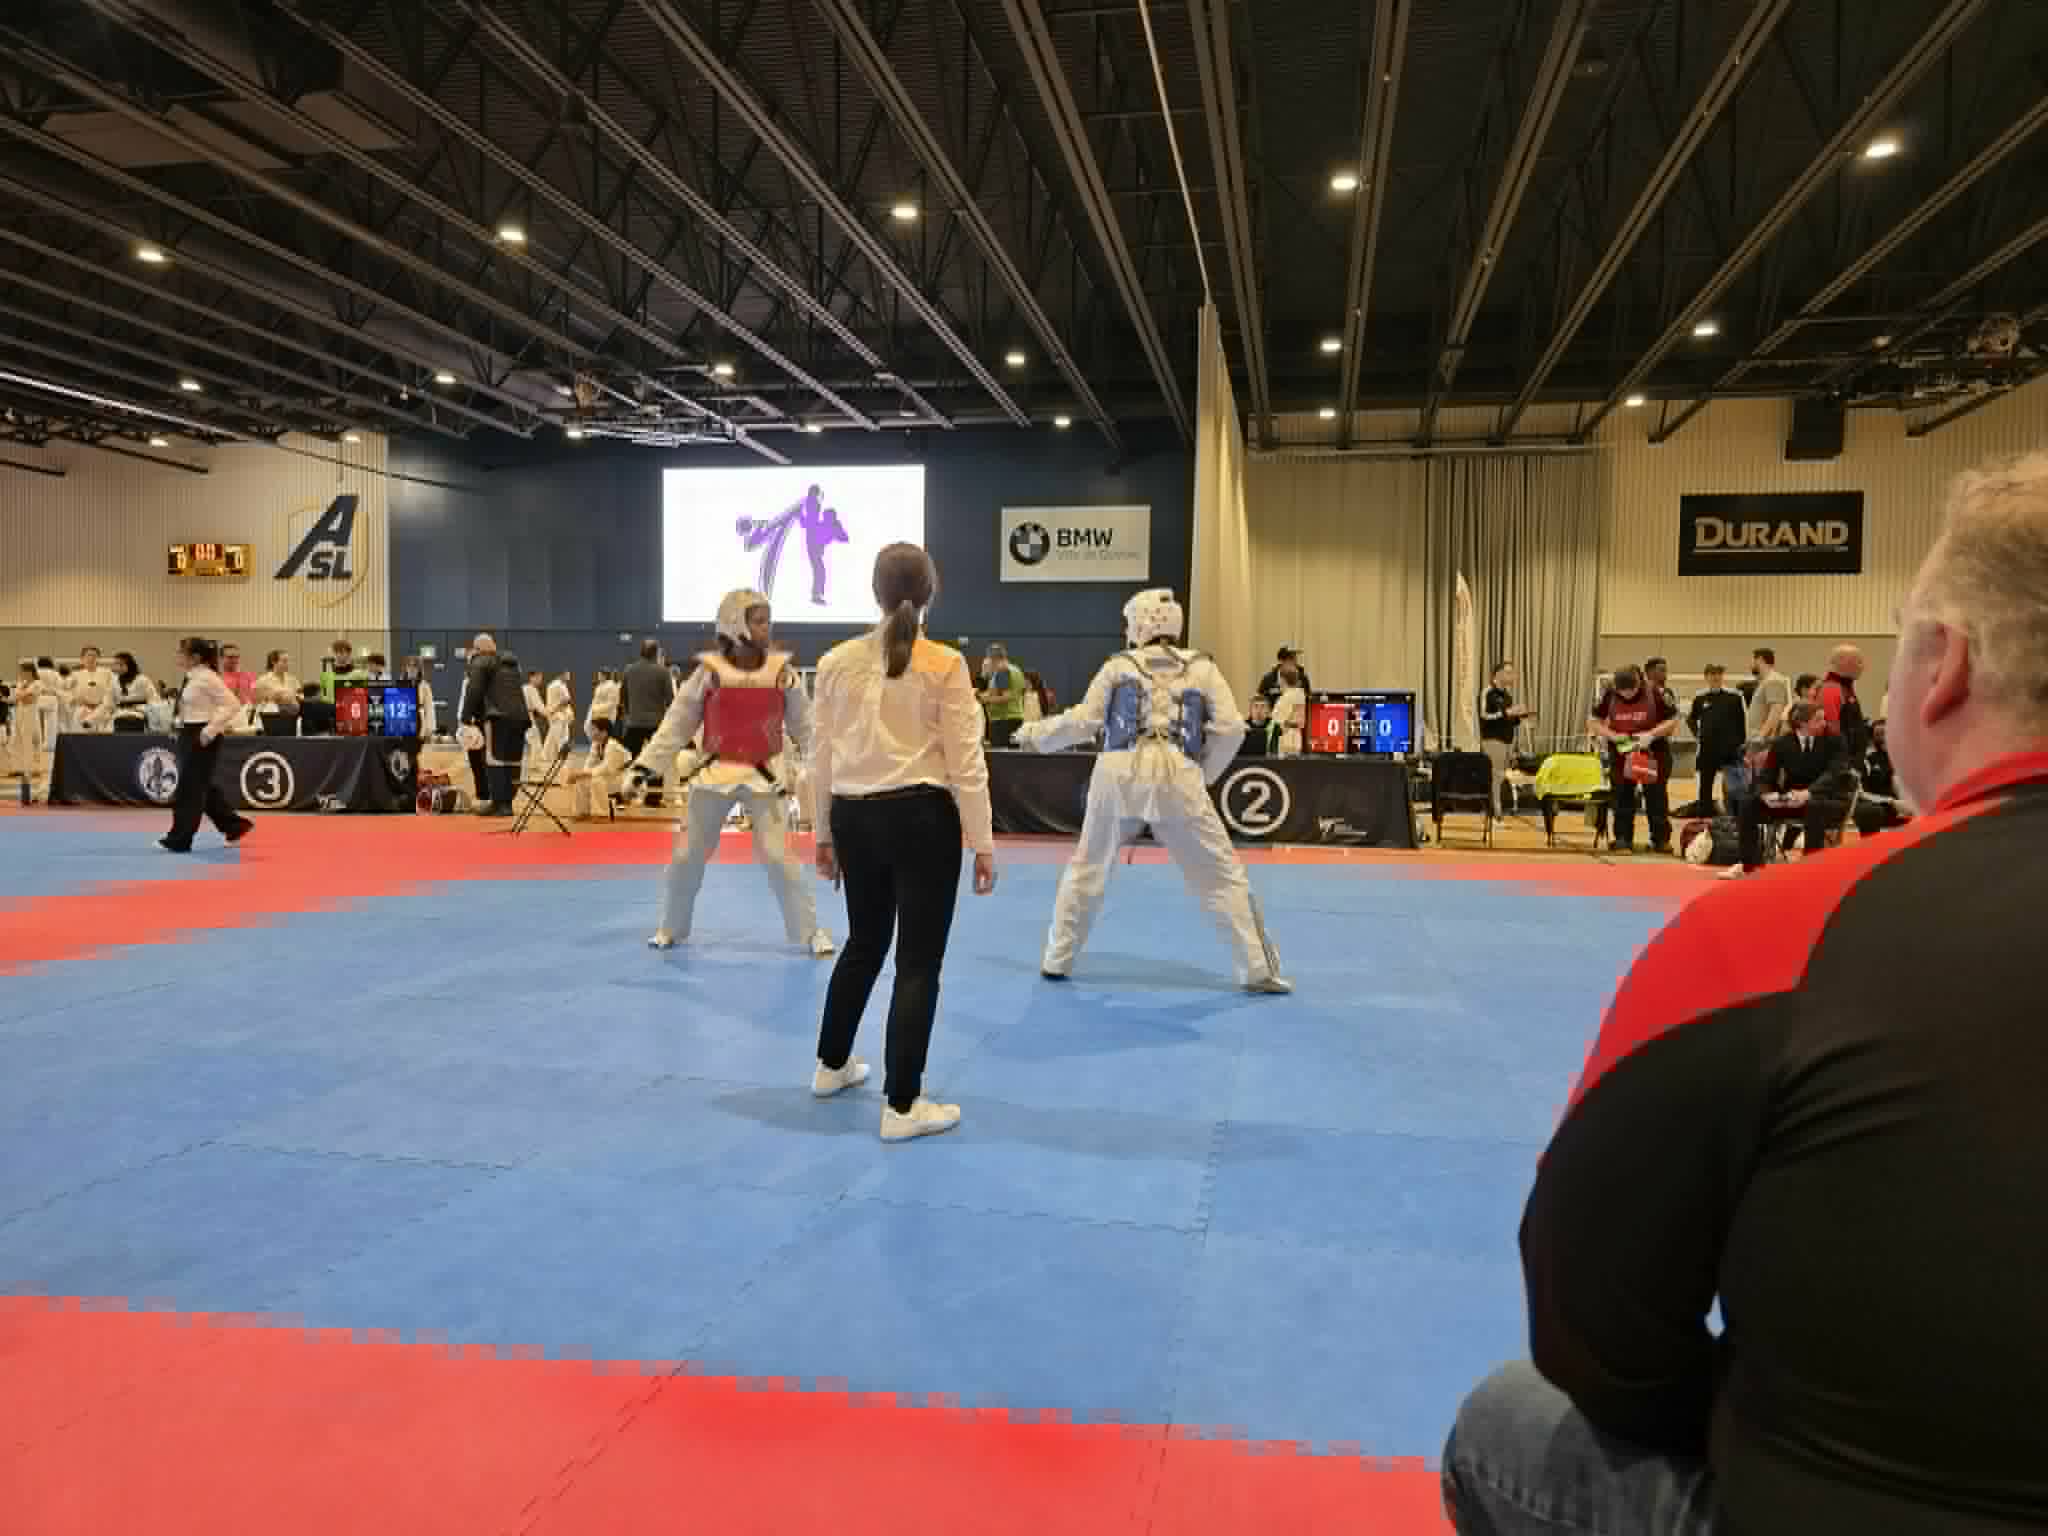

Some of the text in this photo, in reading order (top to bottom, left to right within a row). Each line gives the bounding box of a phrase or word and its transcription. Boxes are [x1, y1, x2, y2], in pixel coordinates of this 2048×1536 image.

[1057, 527, 1113, 548] BMW
[1694, 515, 1849, 547] DURAND
[255, 762, 281, 801] 3
[1241, 780, 1271, 823] 2
